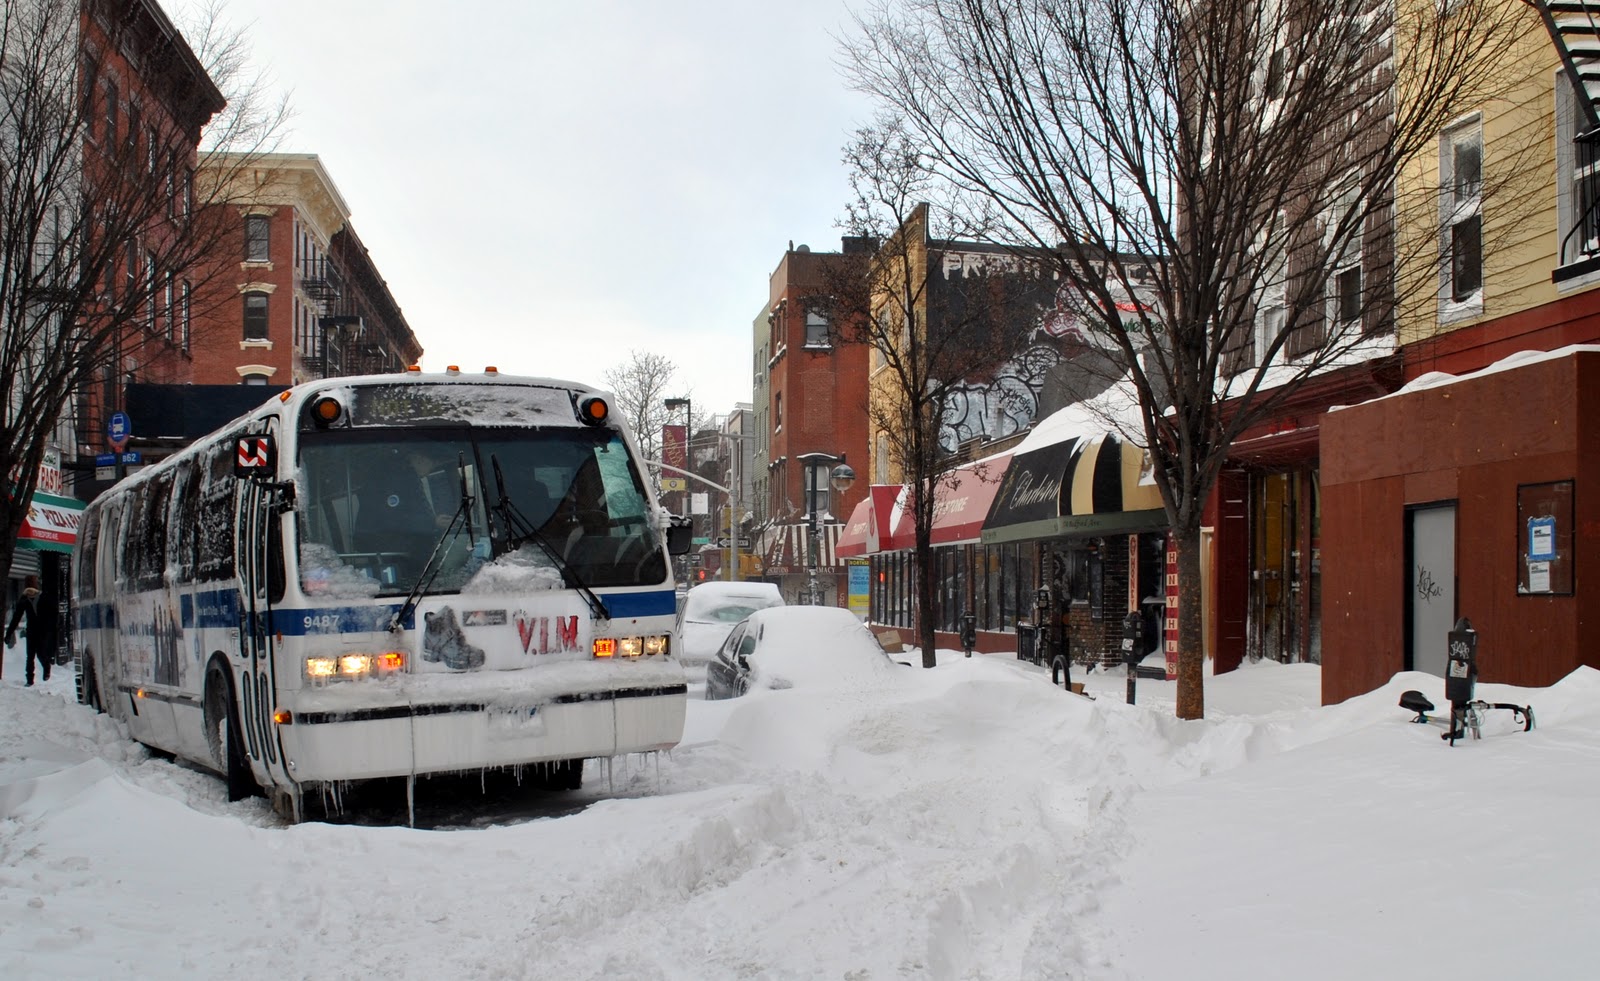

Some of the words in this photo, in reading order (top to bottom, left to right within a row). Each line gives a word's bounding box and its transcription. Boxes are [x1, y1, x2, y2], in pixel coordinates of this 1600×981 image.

[122, 453, 136, 462] B62
[41, 508, 70, 528] PIZZA
[303, 615, 340, 628] 9487
[515, 615, 583, 655] V.I.M.
